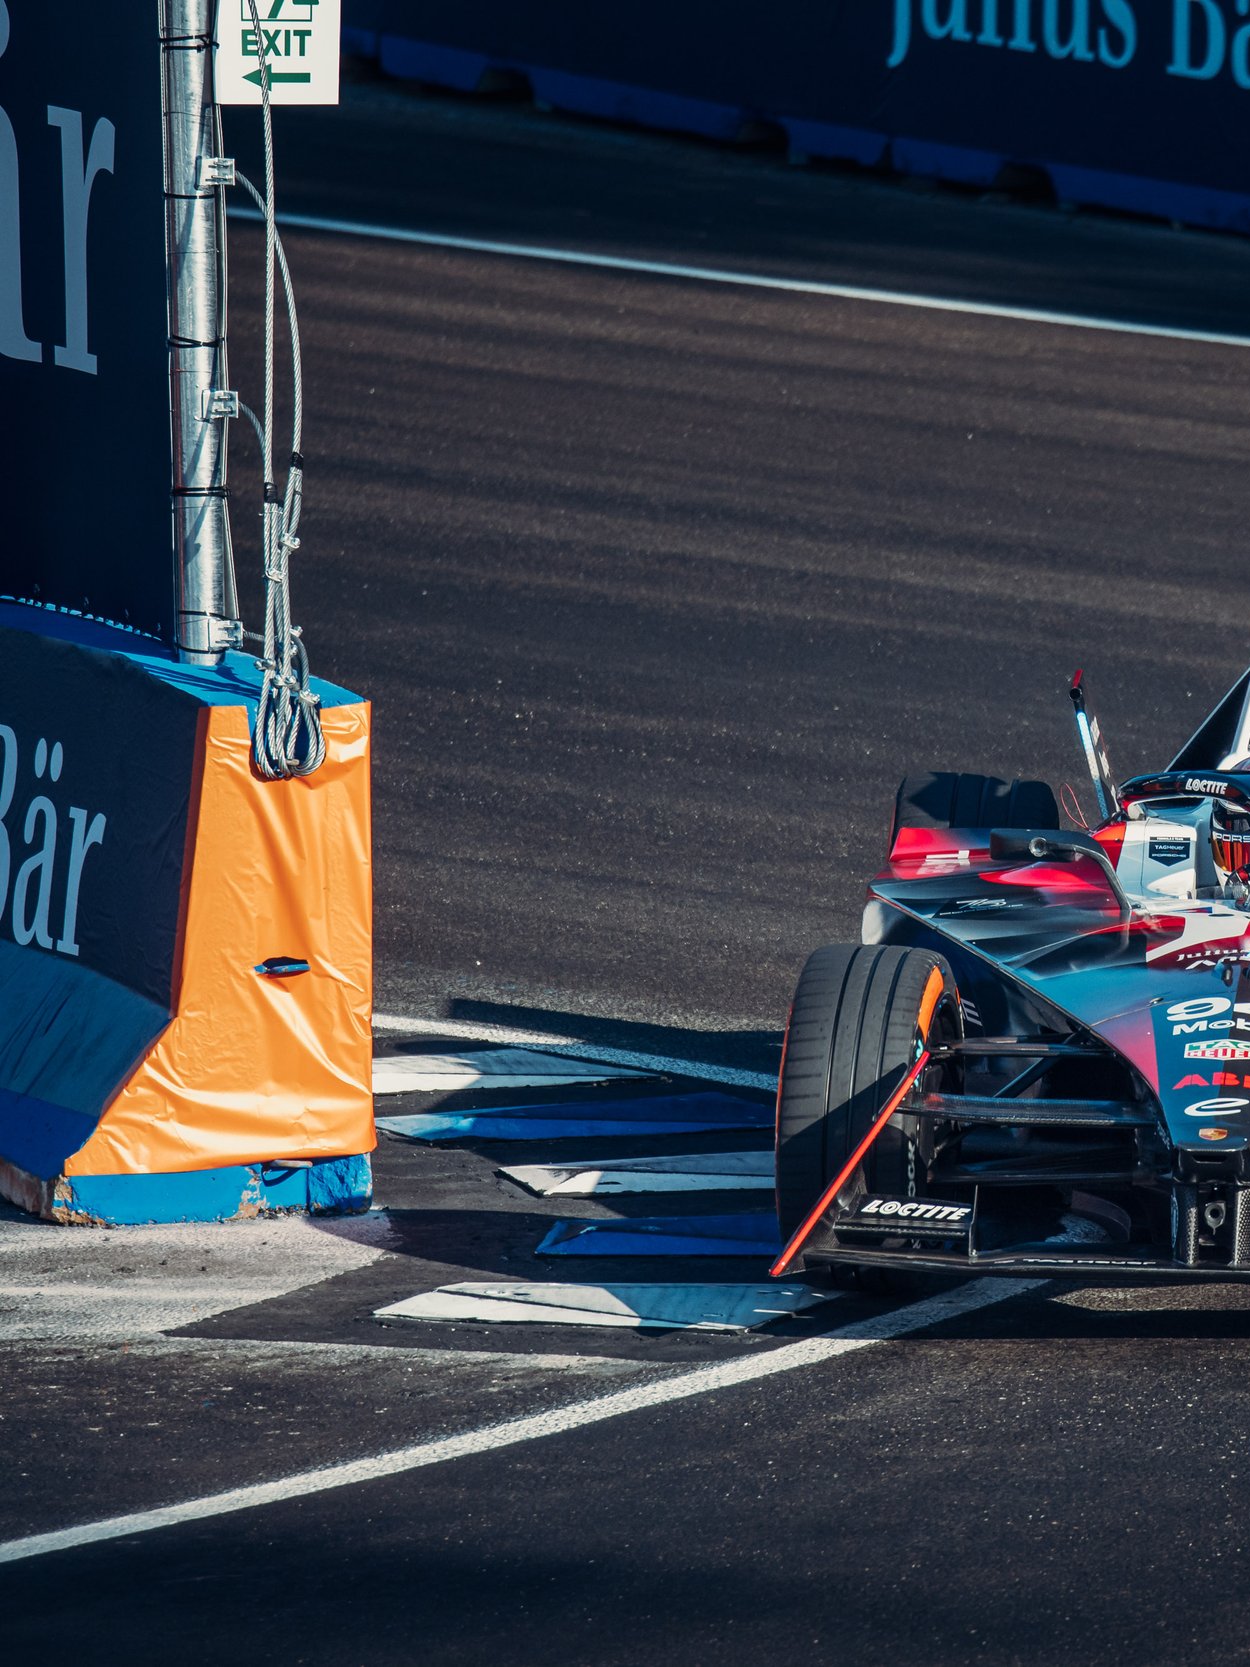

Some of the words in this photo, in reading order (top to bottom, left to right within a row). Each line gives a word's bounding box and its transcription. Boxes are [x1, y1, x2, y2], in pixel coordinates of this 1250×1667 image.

[241, 29, 312, 56] EXIT
[1185, 778, 1228, 795] LOCTITE
[861, 1199, 972, 1220] LOCTITE
